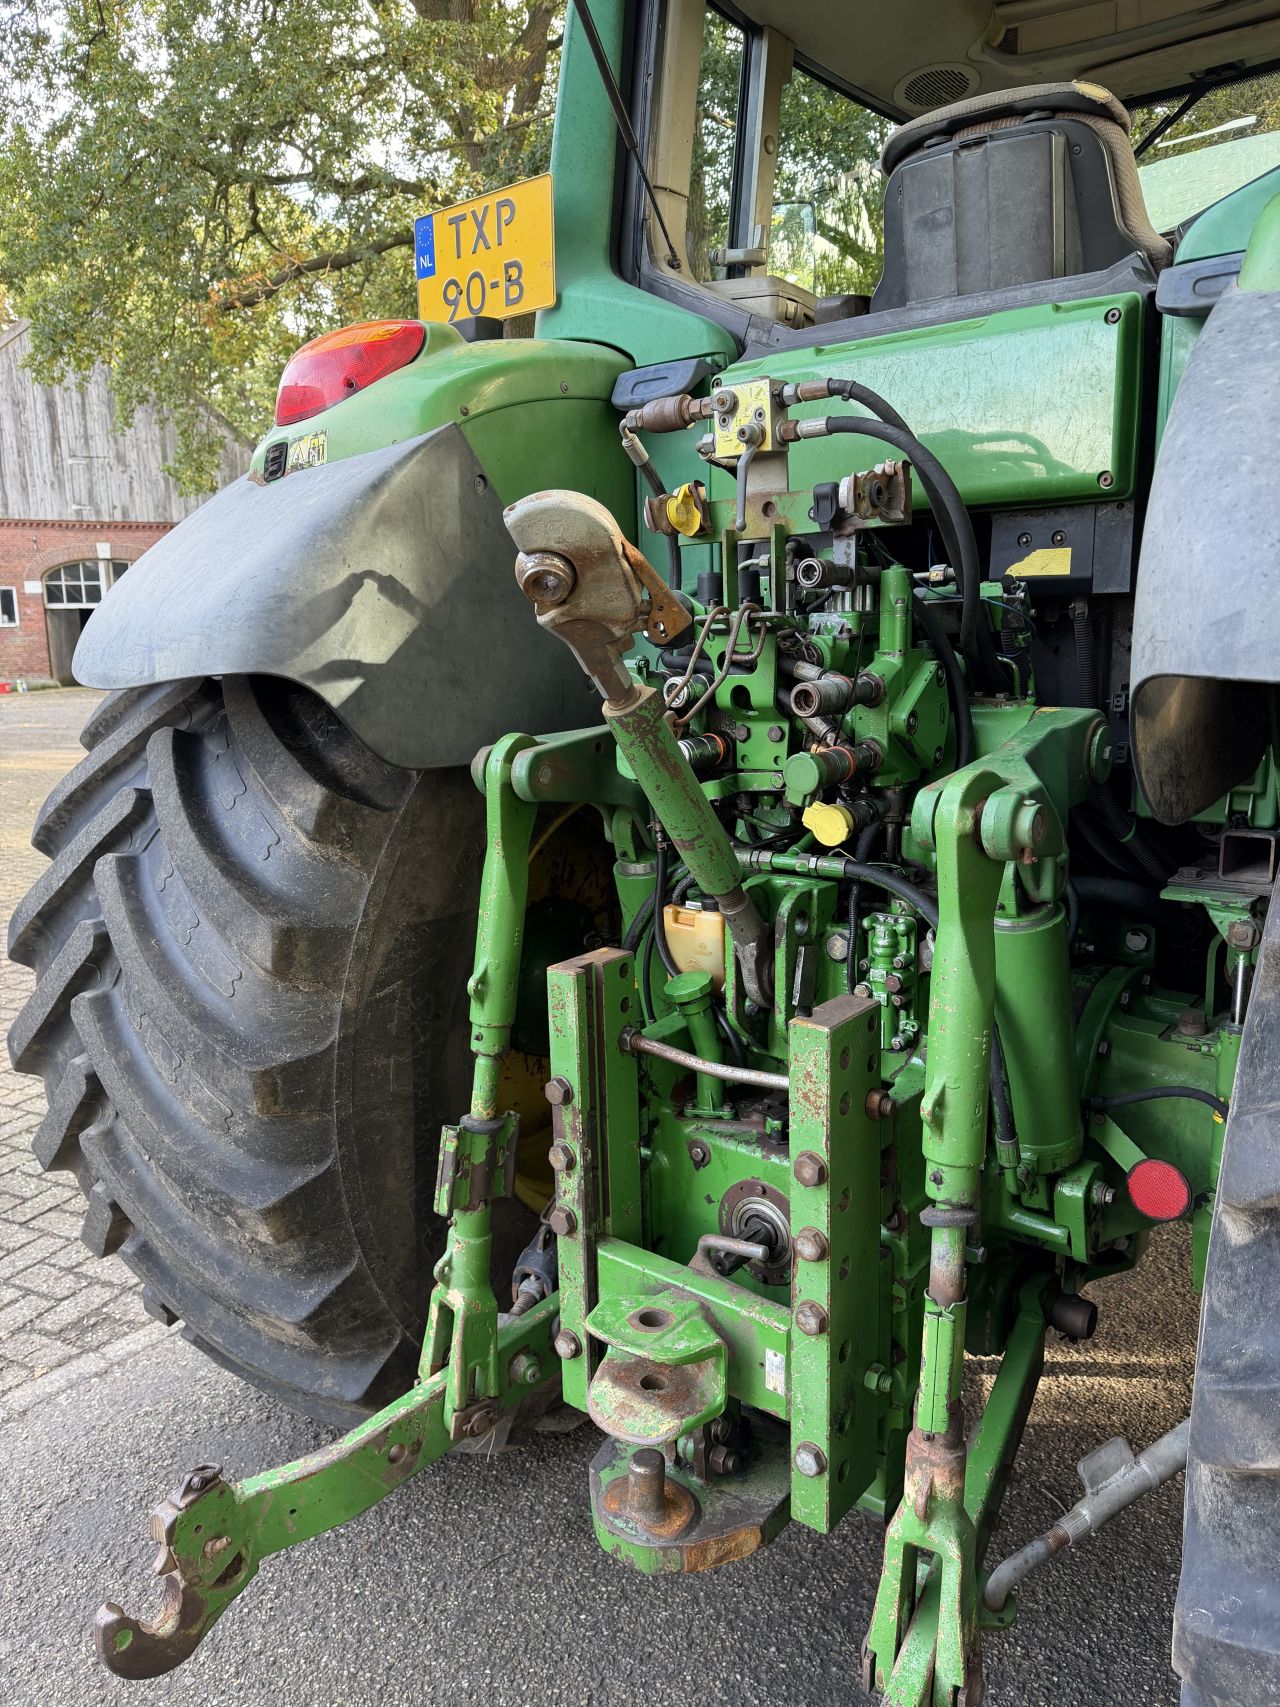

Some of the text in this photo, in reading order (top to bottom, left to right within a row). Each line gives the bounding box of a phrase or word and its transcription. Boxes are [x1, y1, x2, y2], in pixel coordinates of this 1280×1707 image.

[447, 198, 517, 259] TXP
[419, 254, 433, 270] NL
[442, 259, 525, 323] 90-B
